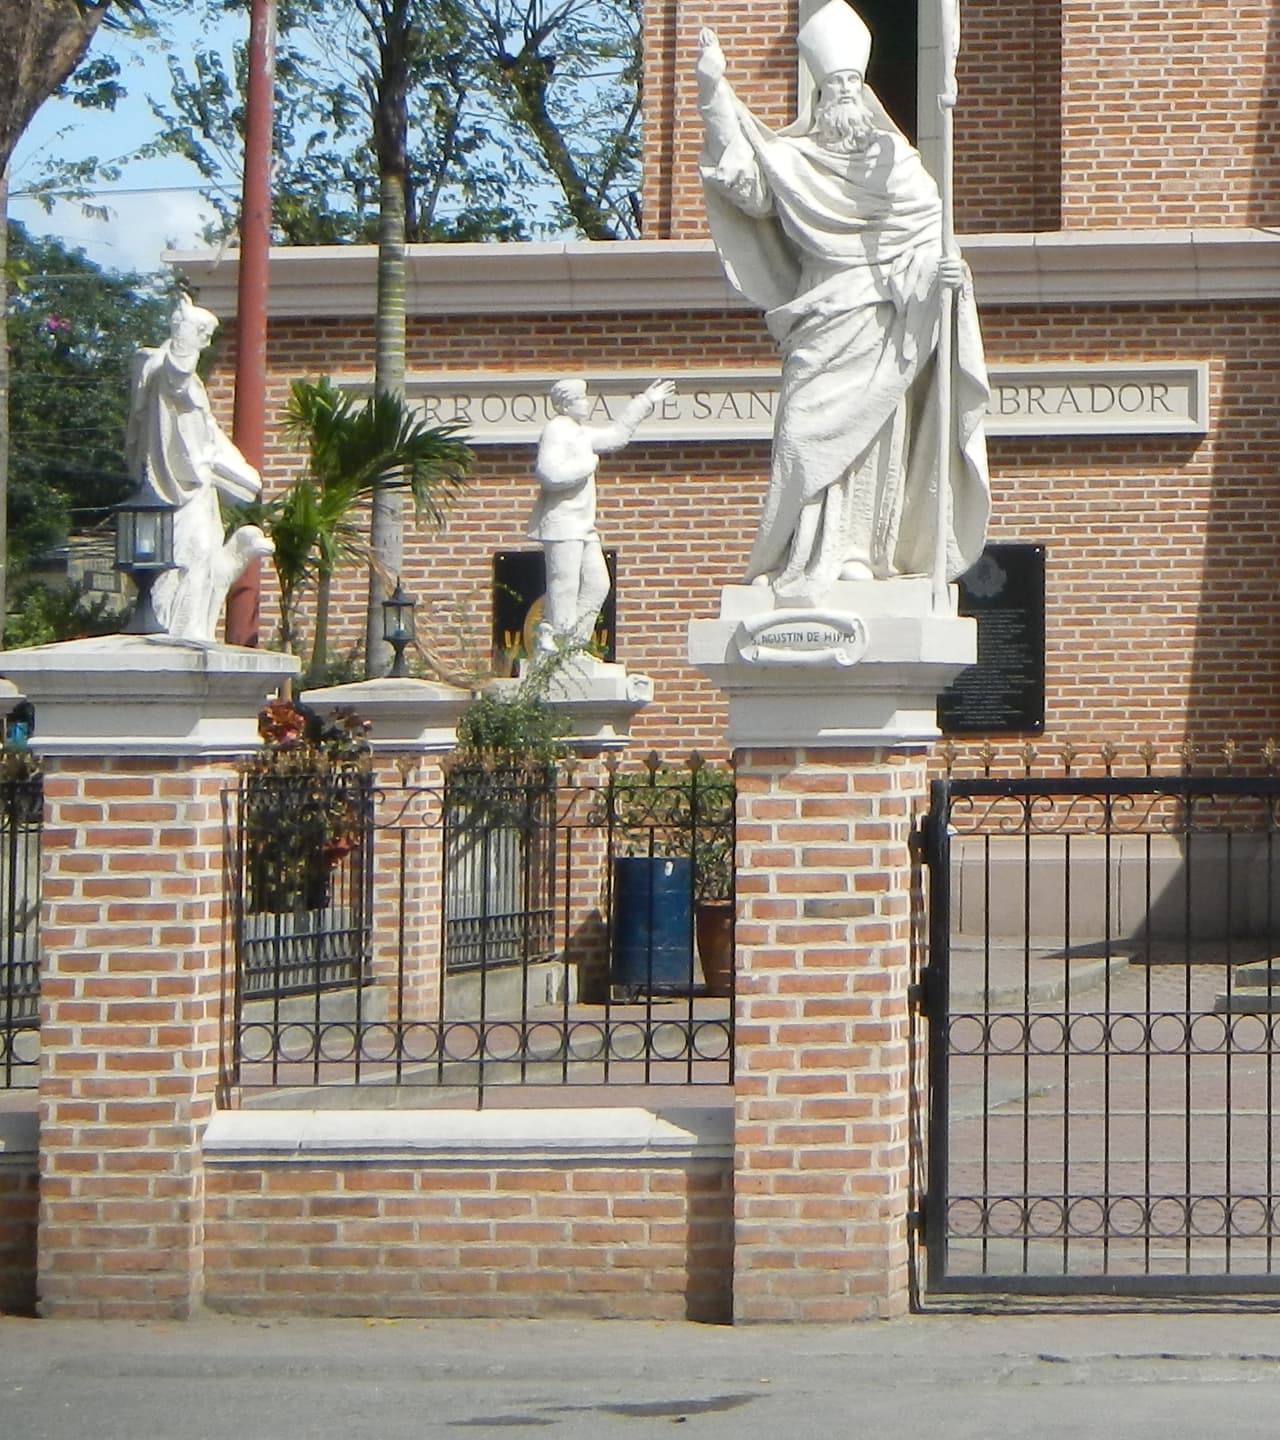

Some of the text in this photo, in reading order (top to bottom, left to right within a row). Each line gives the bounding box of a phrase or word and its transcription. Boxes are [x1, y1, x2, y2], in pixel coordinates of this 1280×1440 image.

[692, 388, 775, 420] SAN
[761, 632, 803, 645] AGUSTIN
[806, 631, 821, 643] DE
[823, 631, 856, 644] HIPPO
